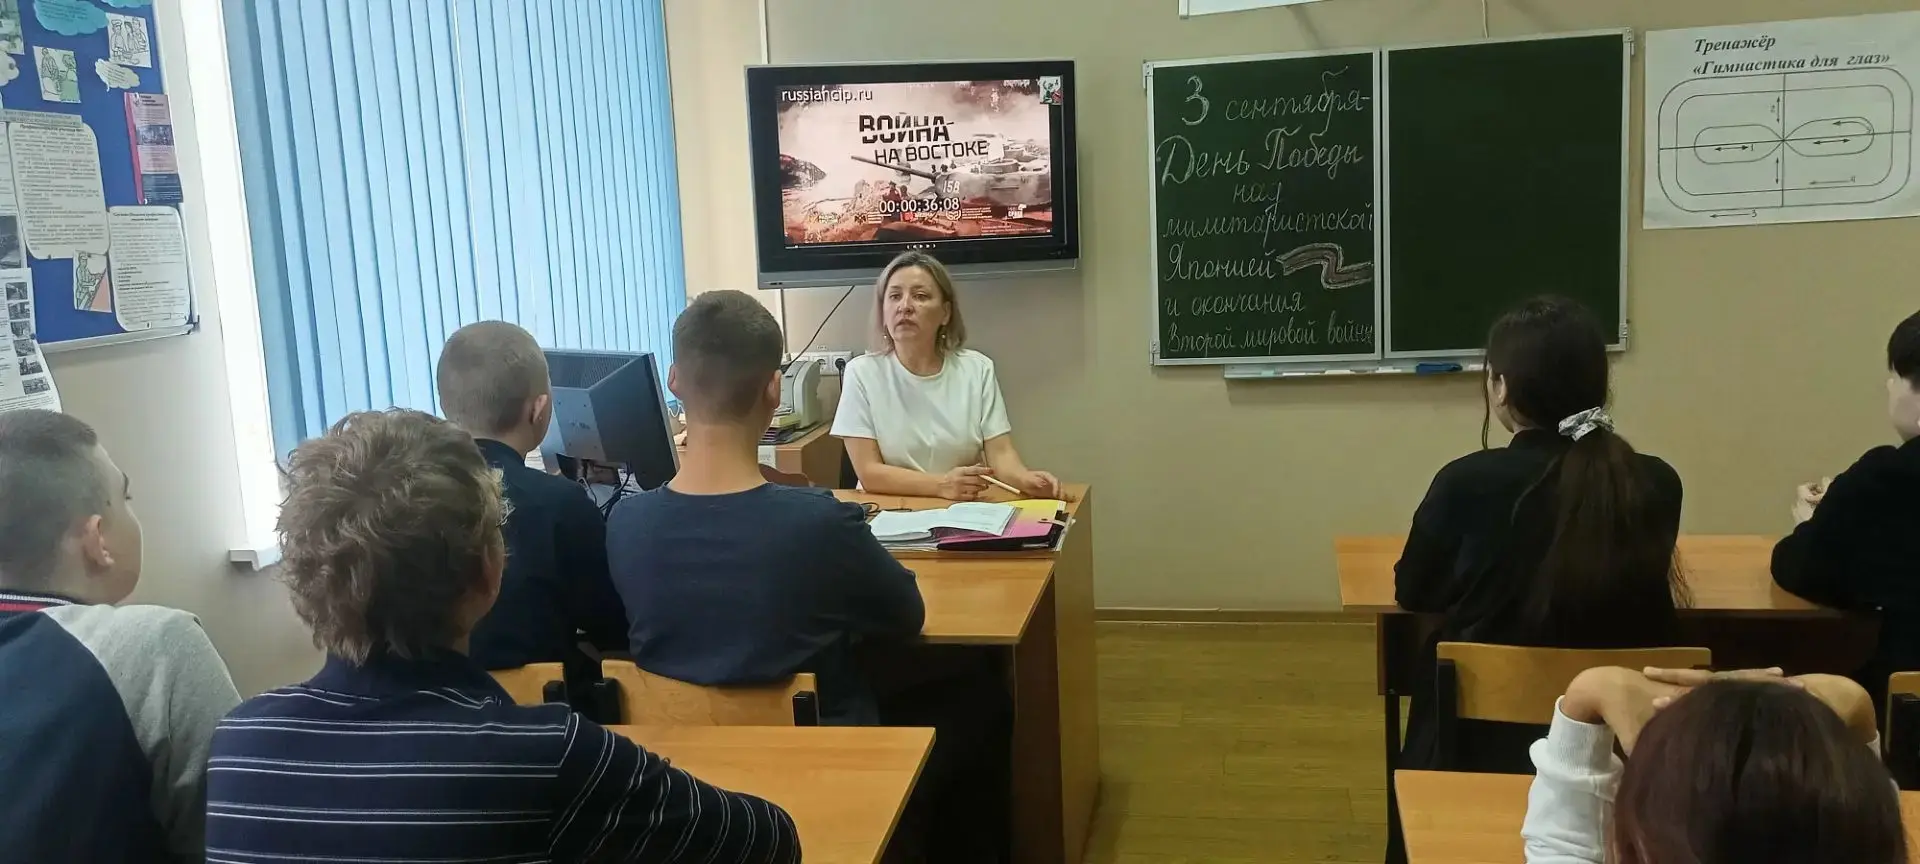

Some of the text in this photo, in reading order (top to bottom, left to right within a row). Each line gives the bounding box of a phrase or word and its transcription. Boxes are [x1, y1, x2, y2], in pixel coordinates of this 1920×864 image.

[1694, 35, 1776, 53] Тренажёр
[1693, 53, 1891, 76] «Гимнастика для глаз»
[1181, 75, 1210, 125] 3
[859, 112, 951, 144] ВОЙНА
[875, 140, 989, 165] НА ВОСТОКЕ
[1156, 124, 1364, 186] День Победы
[879, 198, 960, 214] 00:00:36:08
[1162, 202, 1373, 248] милитаристской
[1164, 241, 1276, 281] Японией
[1164, 291, 1306, 317] и окончания
[1167, 322, 1236, 355] Второй
[1239, 316, 1319, 354] мировой
